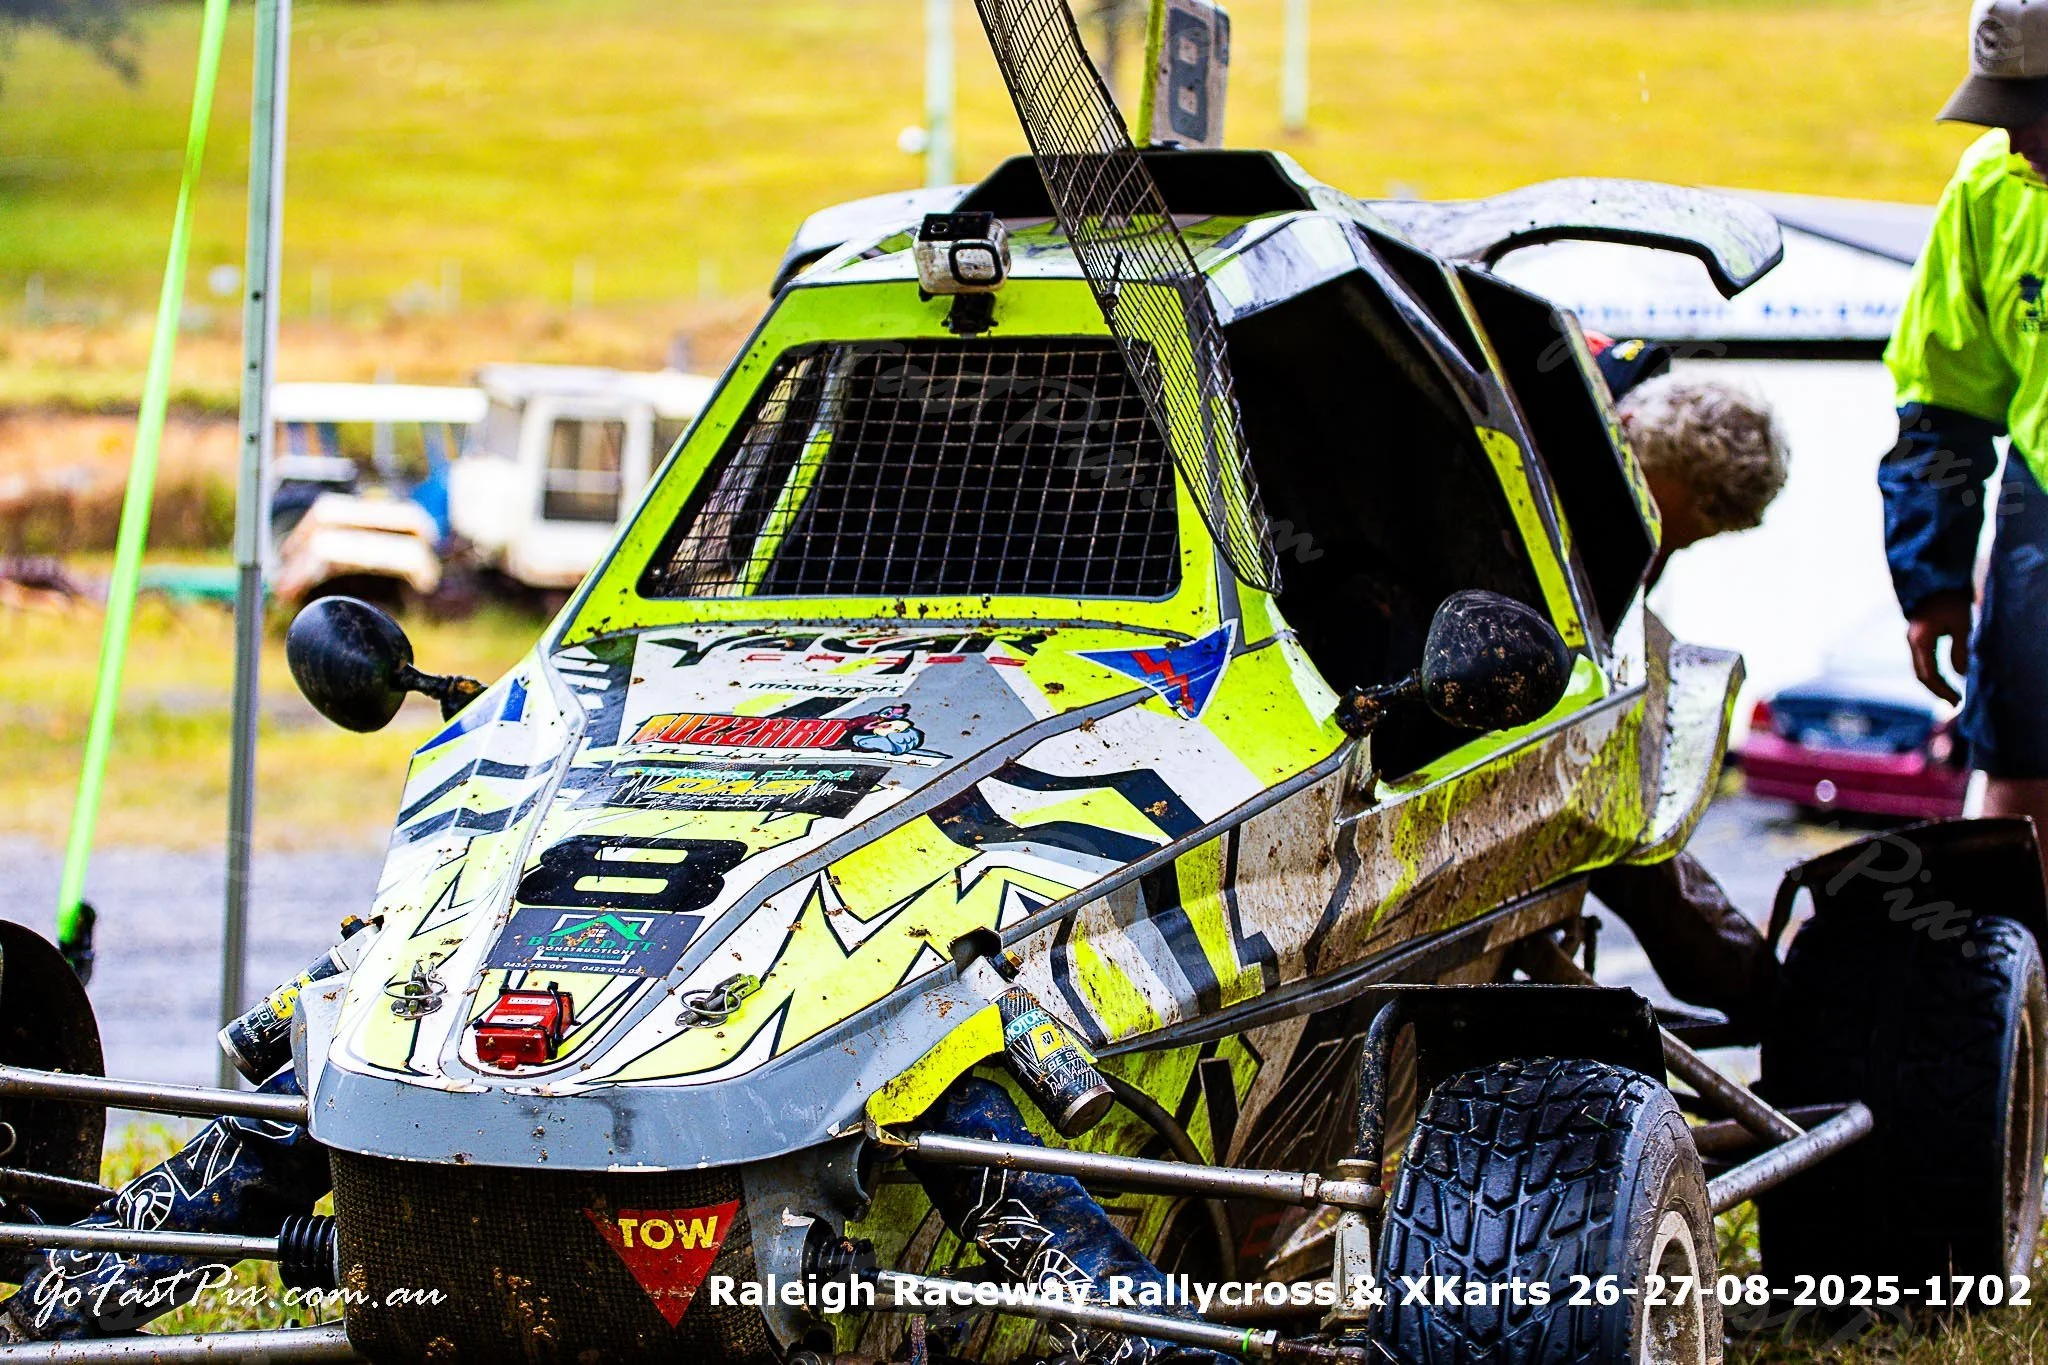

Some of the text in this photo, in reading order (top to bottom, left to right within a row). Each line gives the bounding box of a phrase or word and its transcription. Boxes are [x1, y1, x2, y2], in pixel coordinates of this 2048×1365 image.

[1169, 6, 1210, 142] 8
[748, 681, 904, 697] motorsport
[626, 713, 848, 748] BUZZARD
[515, 834, 748, 912] 8
[527, 935, 618, 949] BULD
[536, 945, 637, 956] CONSTRUCTIONS
[617, 1215, 719, 1250] TOW
